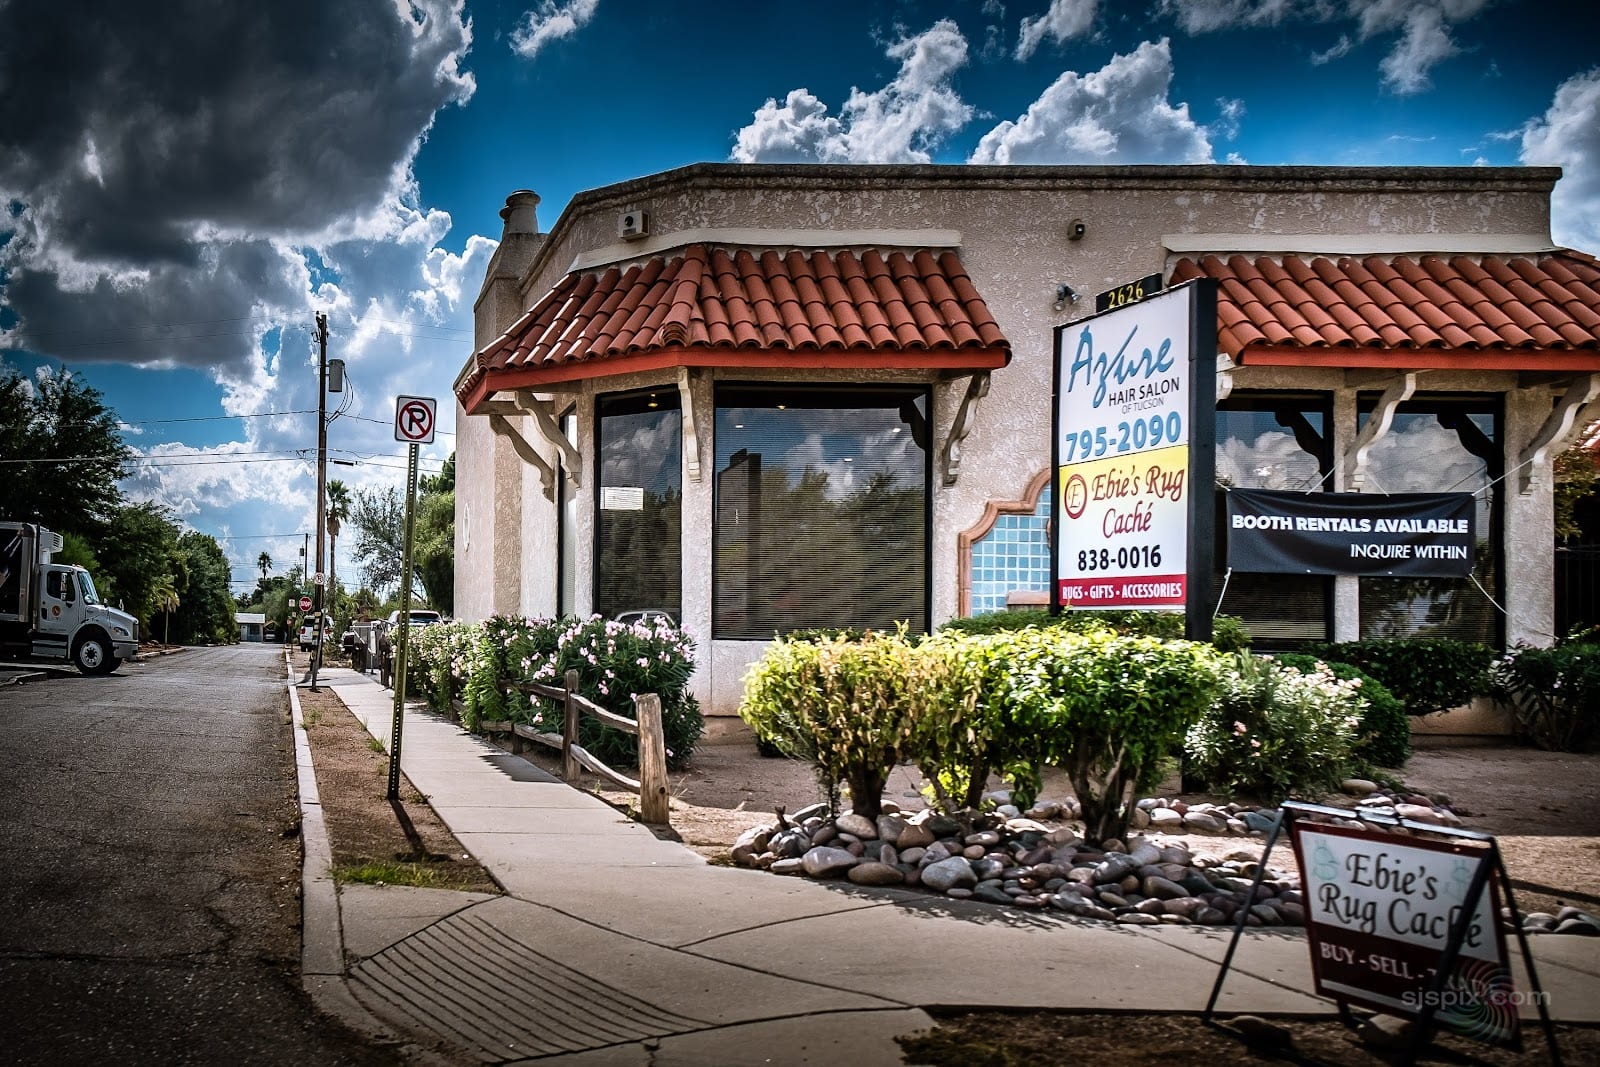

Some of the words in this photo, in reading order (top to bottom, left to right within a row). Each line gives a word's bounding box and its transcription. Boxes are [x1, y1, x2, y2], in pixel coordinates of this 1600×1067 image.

[1108, 282, 1144, 309] 2626
[1068, 324, 1174, 408] Azure
[1109, 388, 1135, 407] HAIR
[1139, 377, 1180, 399] SALON
[1121, 403, 1132, 414] OF
[1132, 398, 1164, 410] TUCSON
[1066, 411, 1181, 461] 795-2090
[1068, 484, 1081, 508] E
[1092, 465, 1140, 501] Ebie's
[1146, 465, 1185, 502] Rug
[1103, 500, 1154, 538] Caché
[1232, 514, 1293, 531] BOOTH
[1295, 517, 1372, 533] RENTALS
[1374, 519, 1469, 534] AVAILABLE
[1078, 545, 1162, 571] 838-0016
[1350, 544, 1411, 560] INQUIRE
[1414, 545, 1467, 560] WITHIN
[1062, 586, 1083, 599] RUGS
[1089, 585, 1114, 598] GIFTS
[1121, 582, 1182, 598] ACCESSORIES
[1346, 853, 1439, 900] Ebie's
[1318, 882, 1378, 935] Rug
[1320, 942, 1355, 965] BUY
[1368, 954, 1414, 980] SELL
